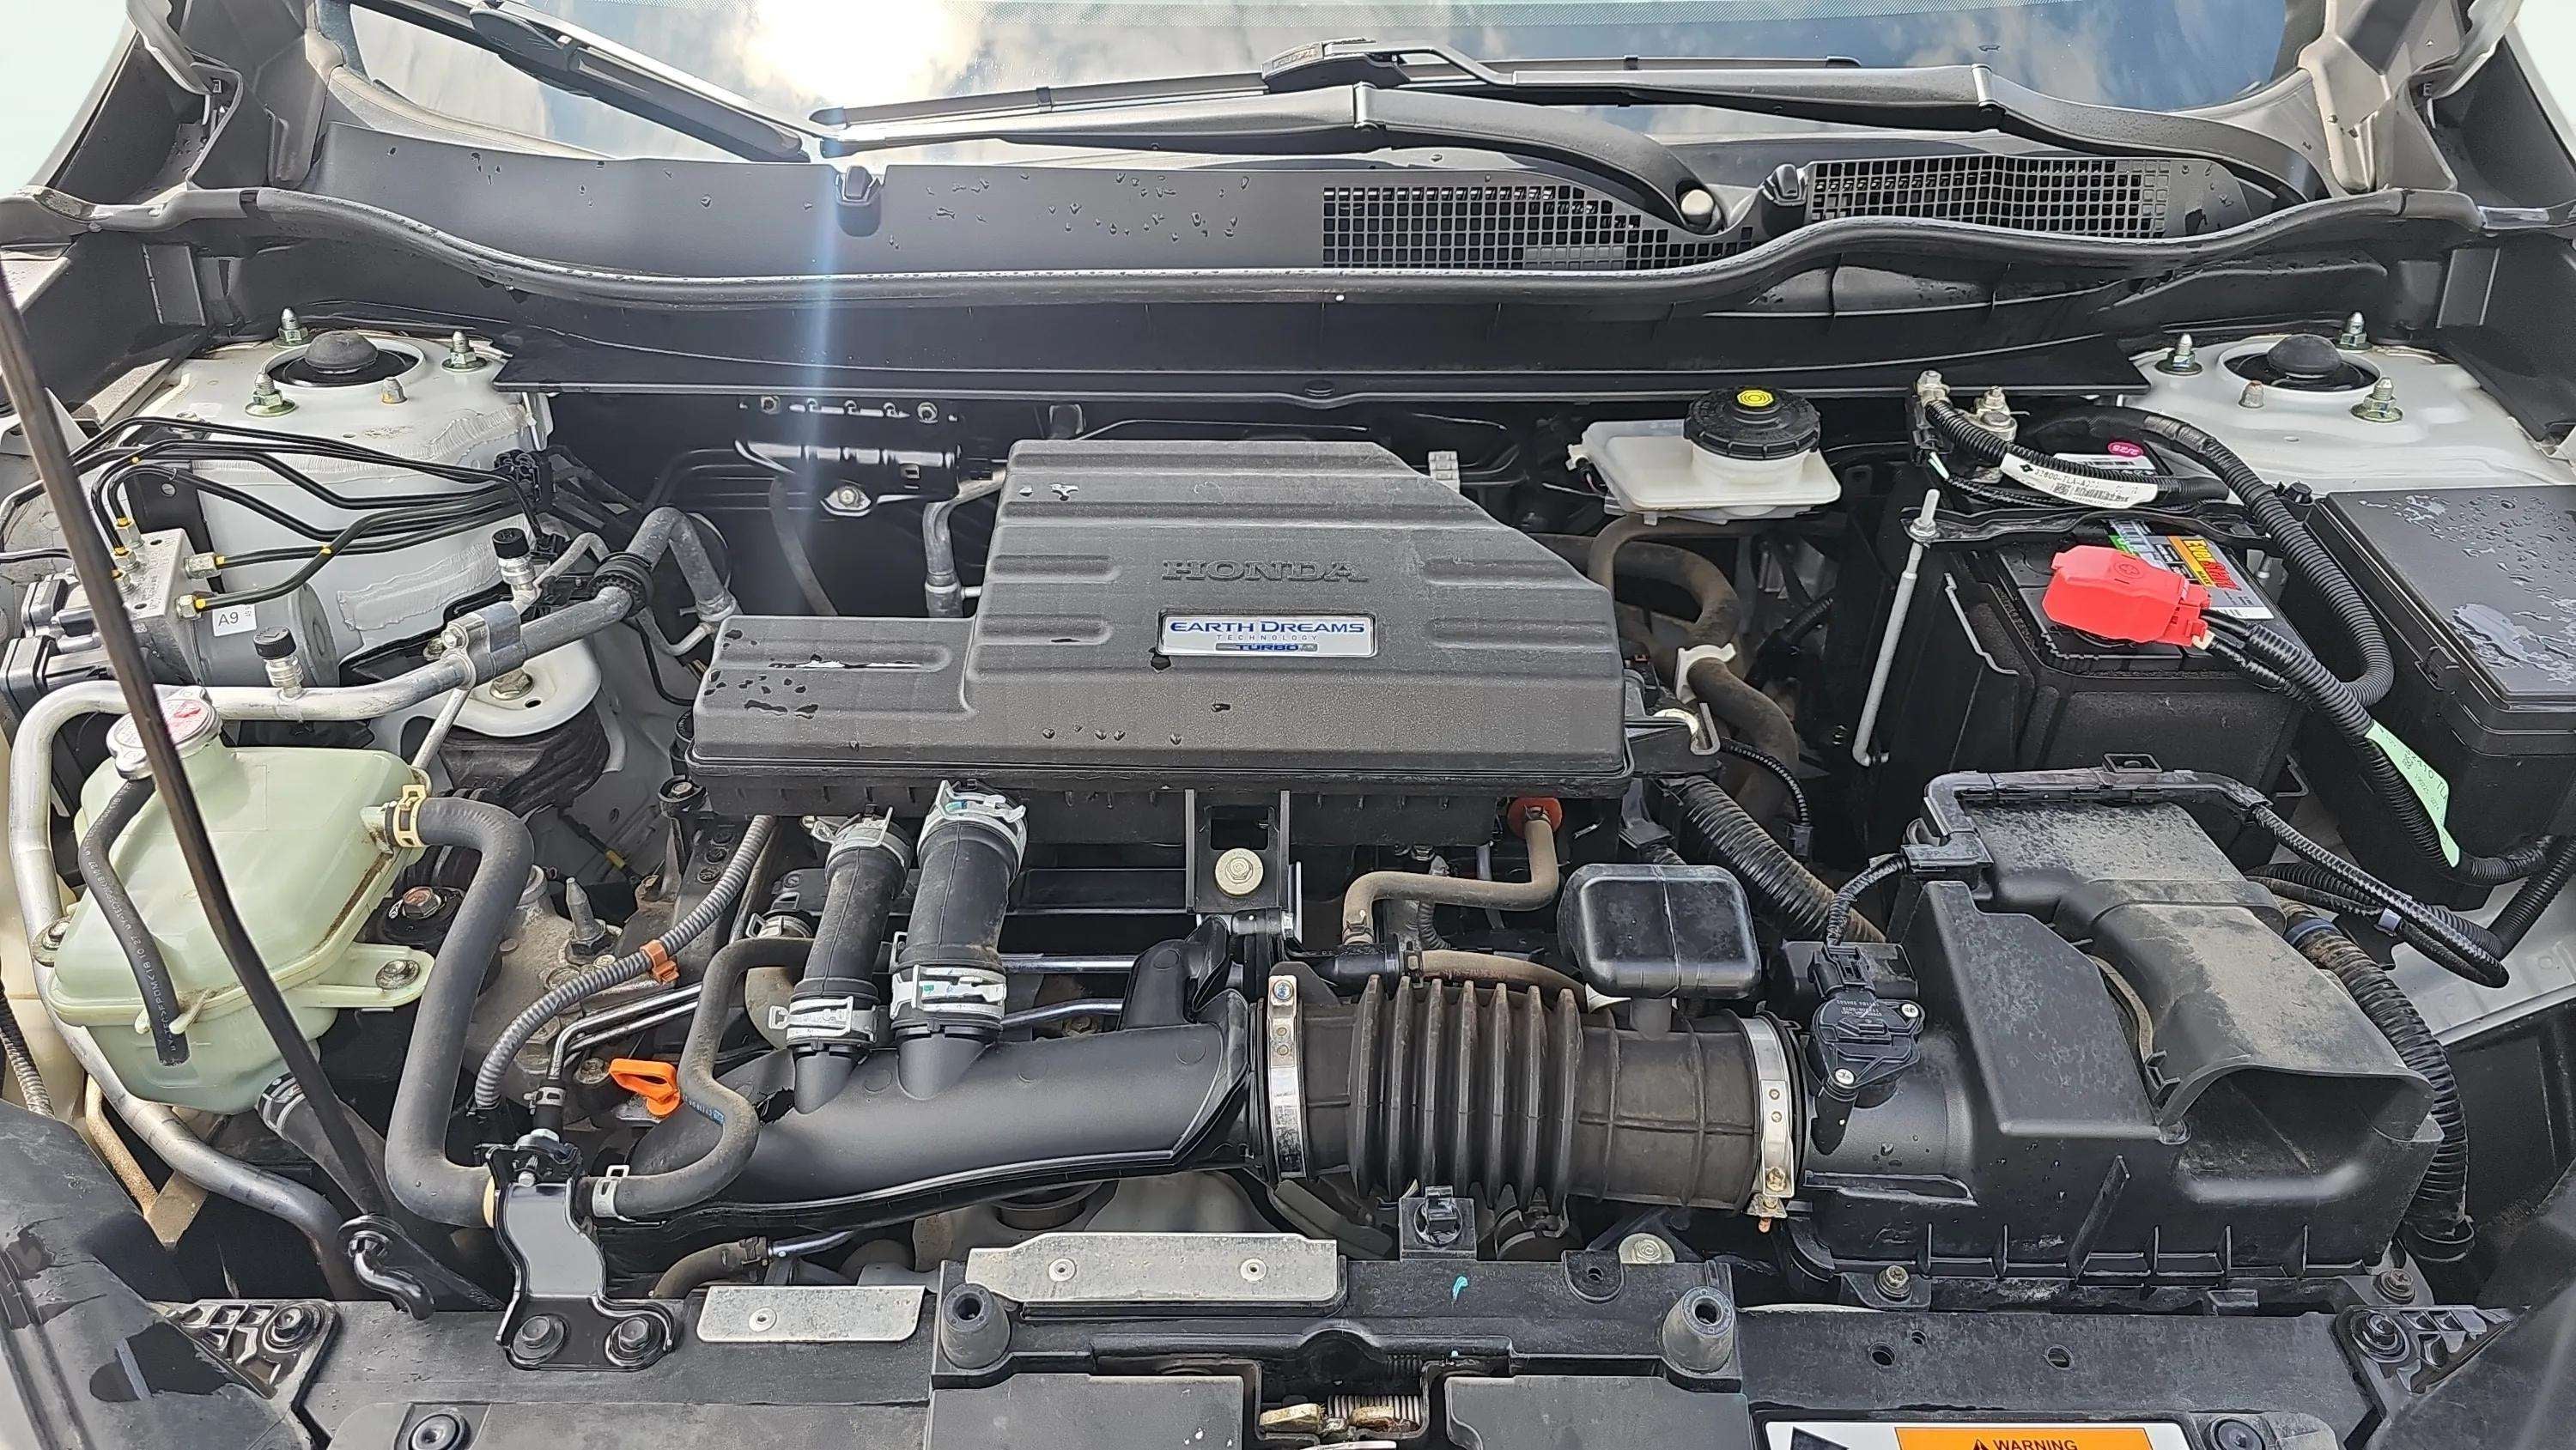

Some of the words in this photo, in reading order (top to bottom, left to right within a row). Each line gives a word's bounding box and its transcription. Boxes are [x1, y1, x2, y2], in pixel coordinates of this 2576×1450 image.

[1162, 561, 1370, 583] HONDA
[218, 611, 239, 627] A9
[1170, 622, 1254, 633] EARTH
[1260, 621, 1365, 634] DREAMS
